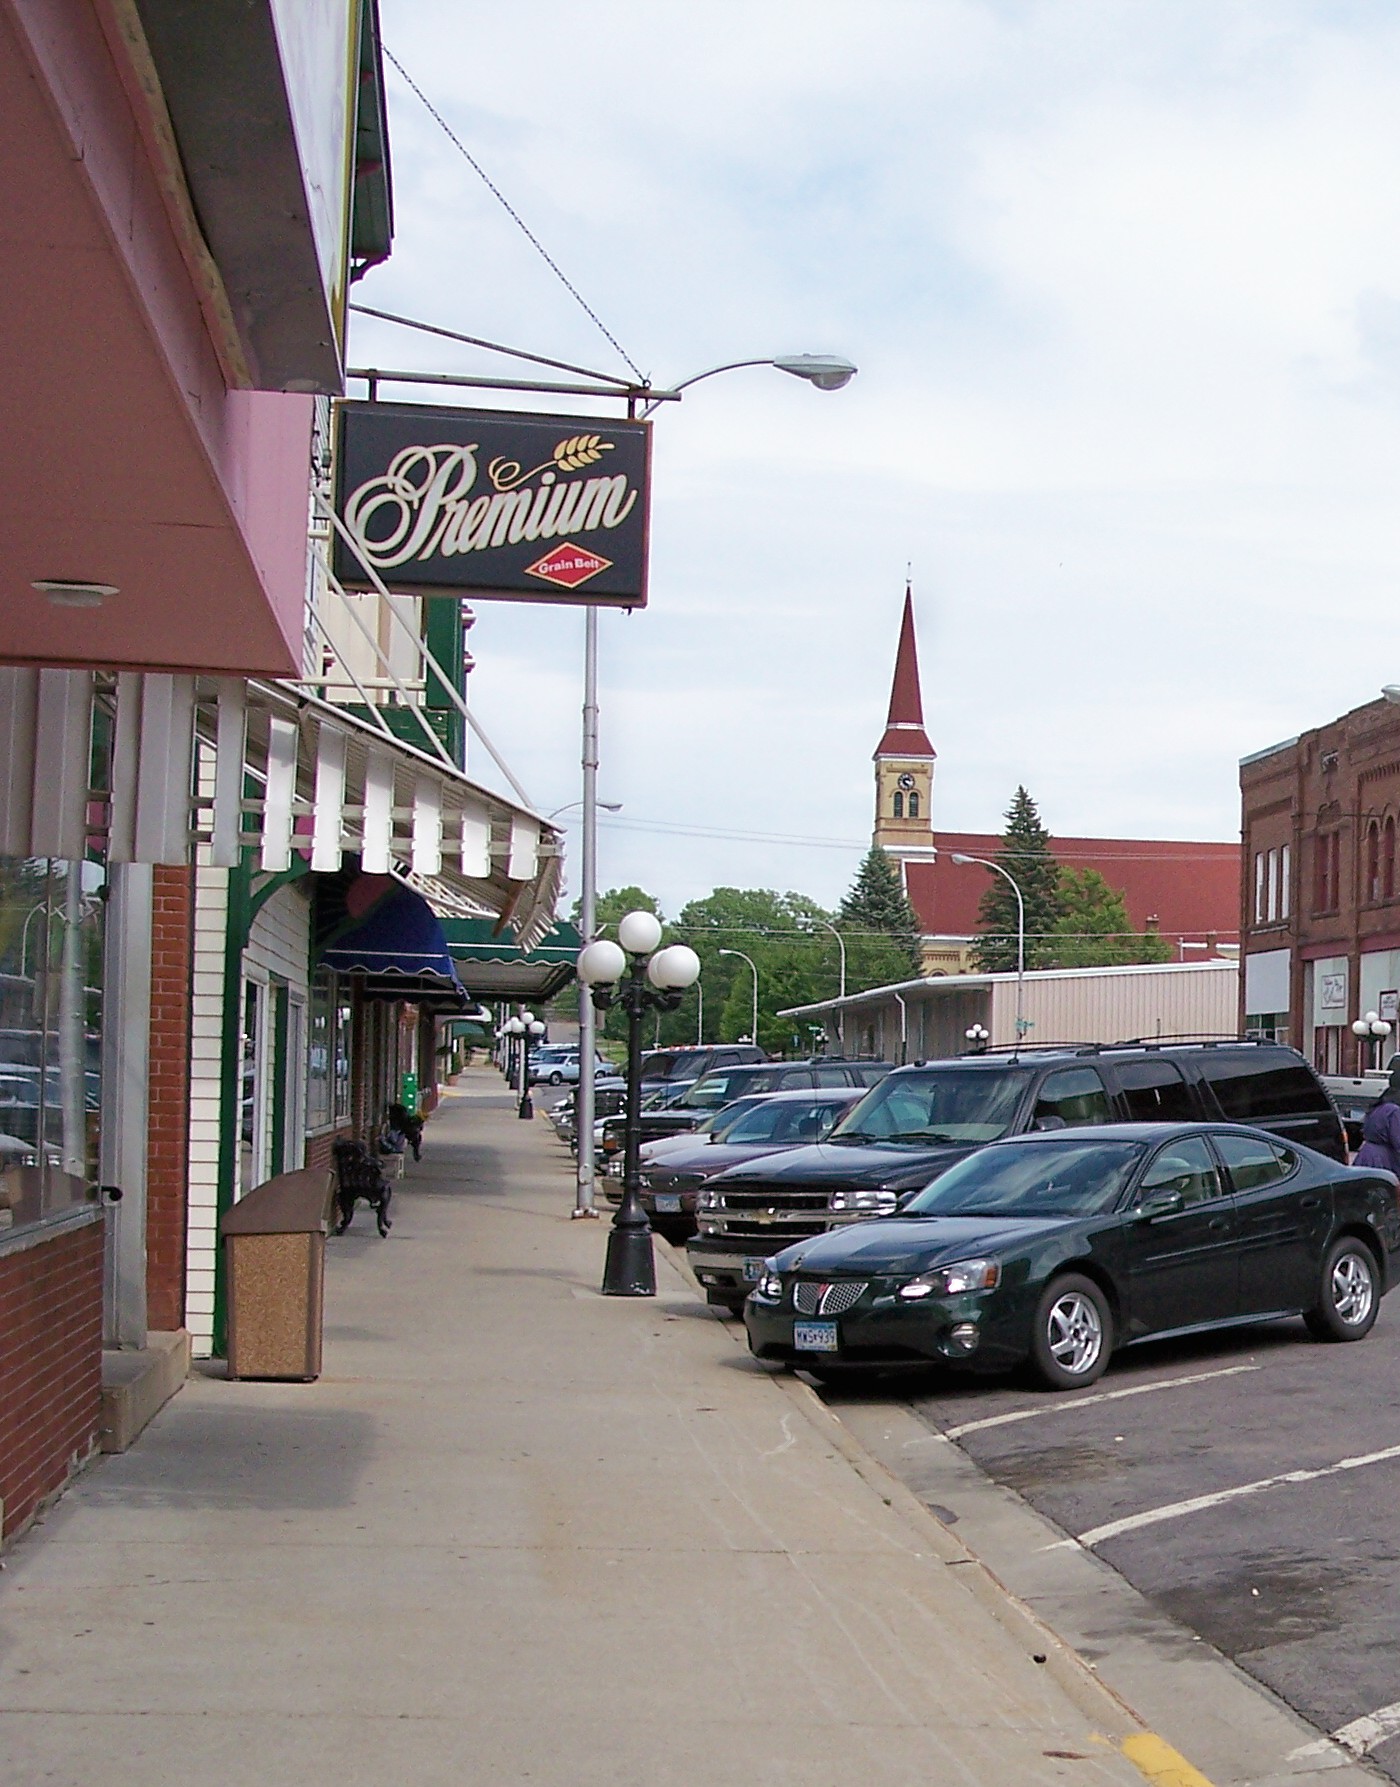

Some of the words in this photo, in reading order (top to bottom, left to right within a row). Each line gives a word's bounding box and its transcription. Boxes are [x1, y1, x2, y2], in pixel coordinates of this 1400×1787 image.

[344, 443, 638, 568] Premium
[538, 559, 573, 574] Grain
[574, 557, 599, 569] Belt
